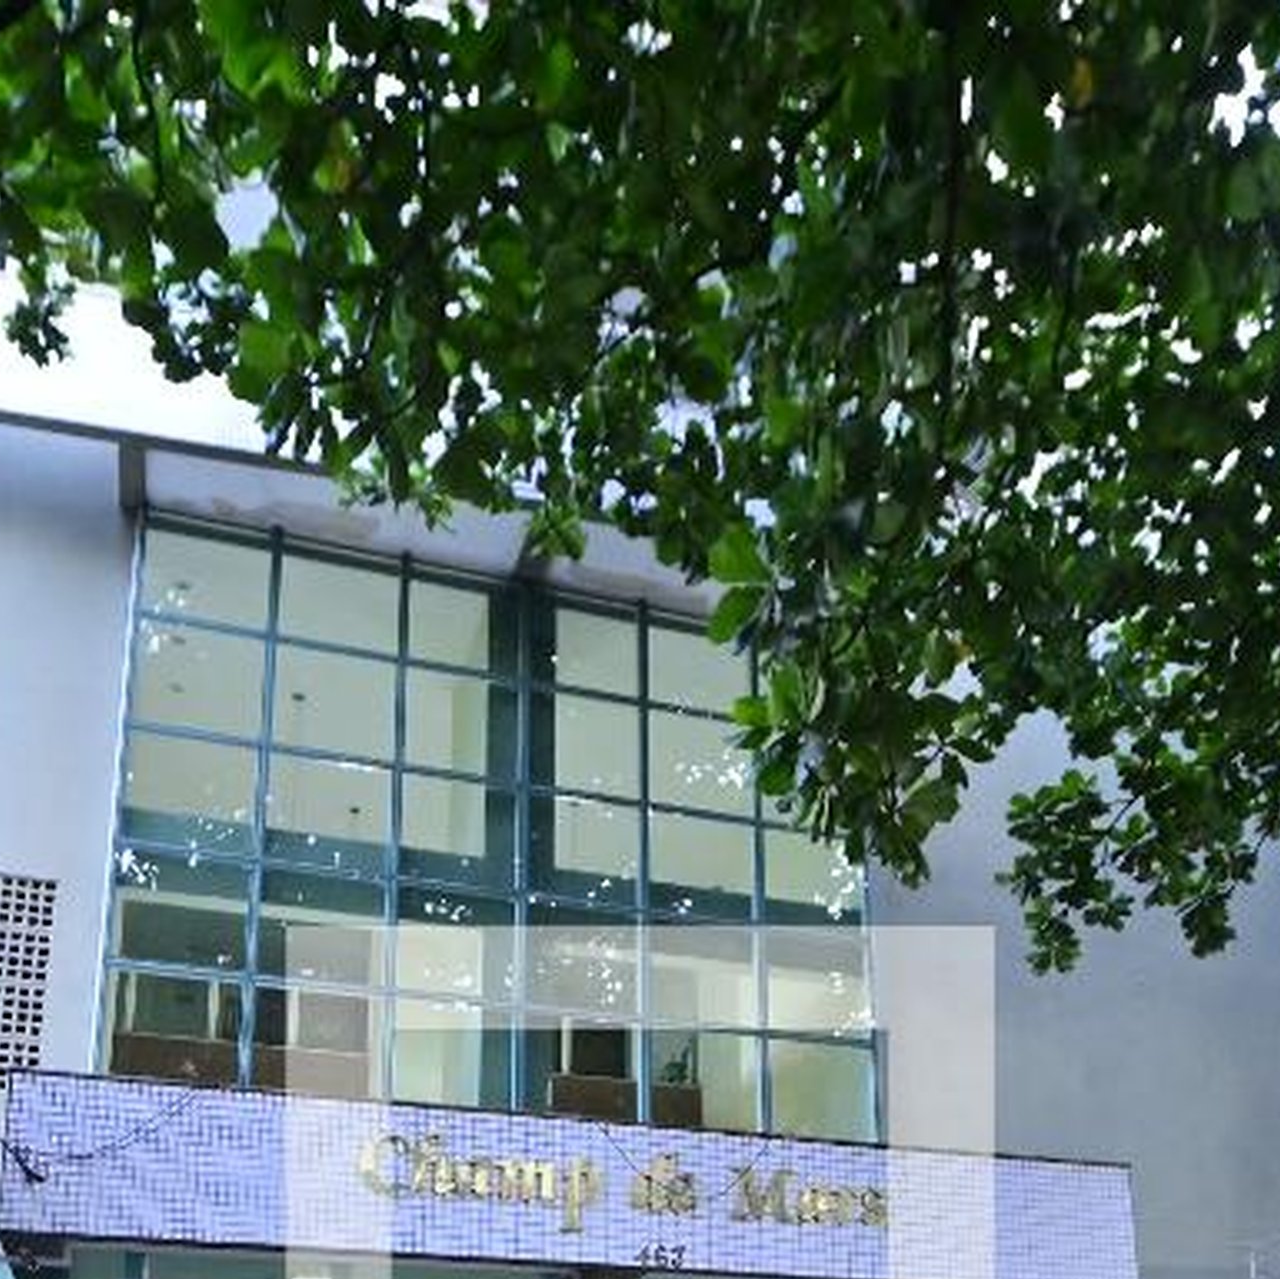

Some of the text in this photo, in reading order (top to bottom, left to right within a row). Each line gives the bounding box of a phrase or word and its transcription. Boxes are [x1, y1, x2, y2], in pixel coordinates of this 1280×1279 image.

[358, 1132, 890, 1234] Champ de Mars
